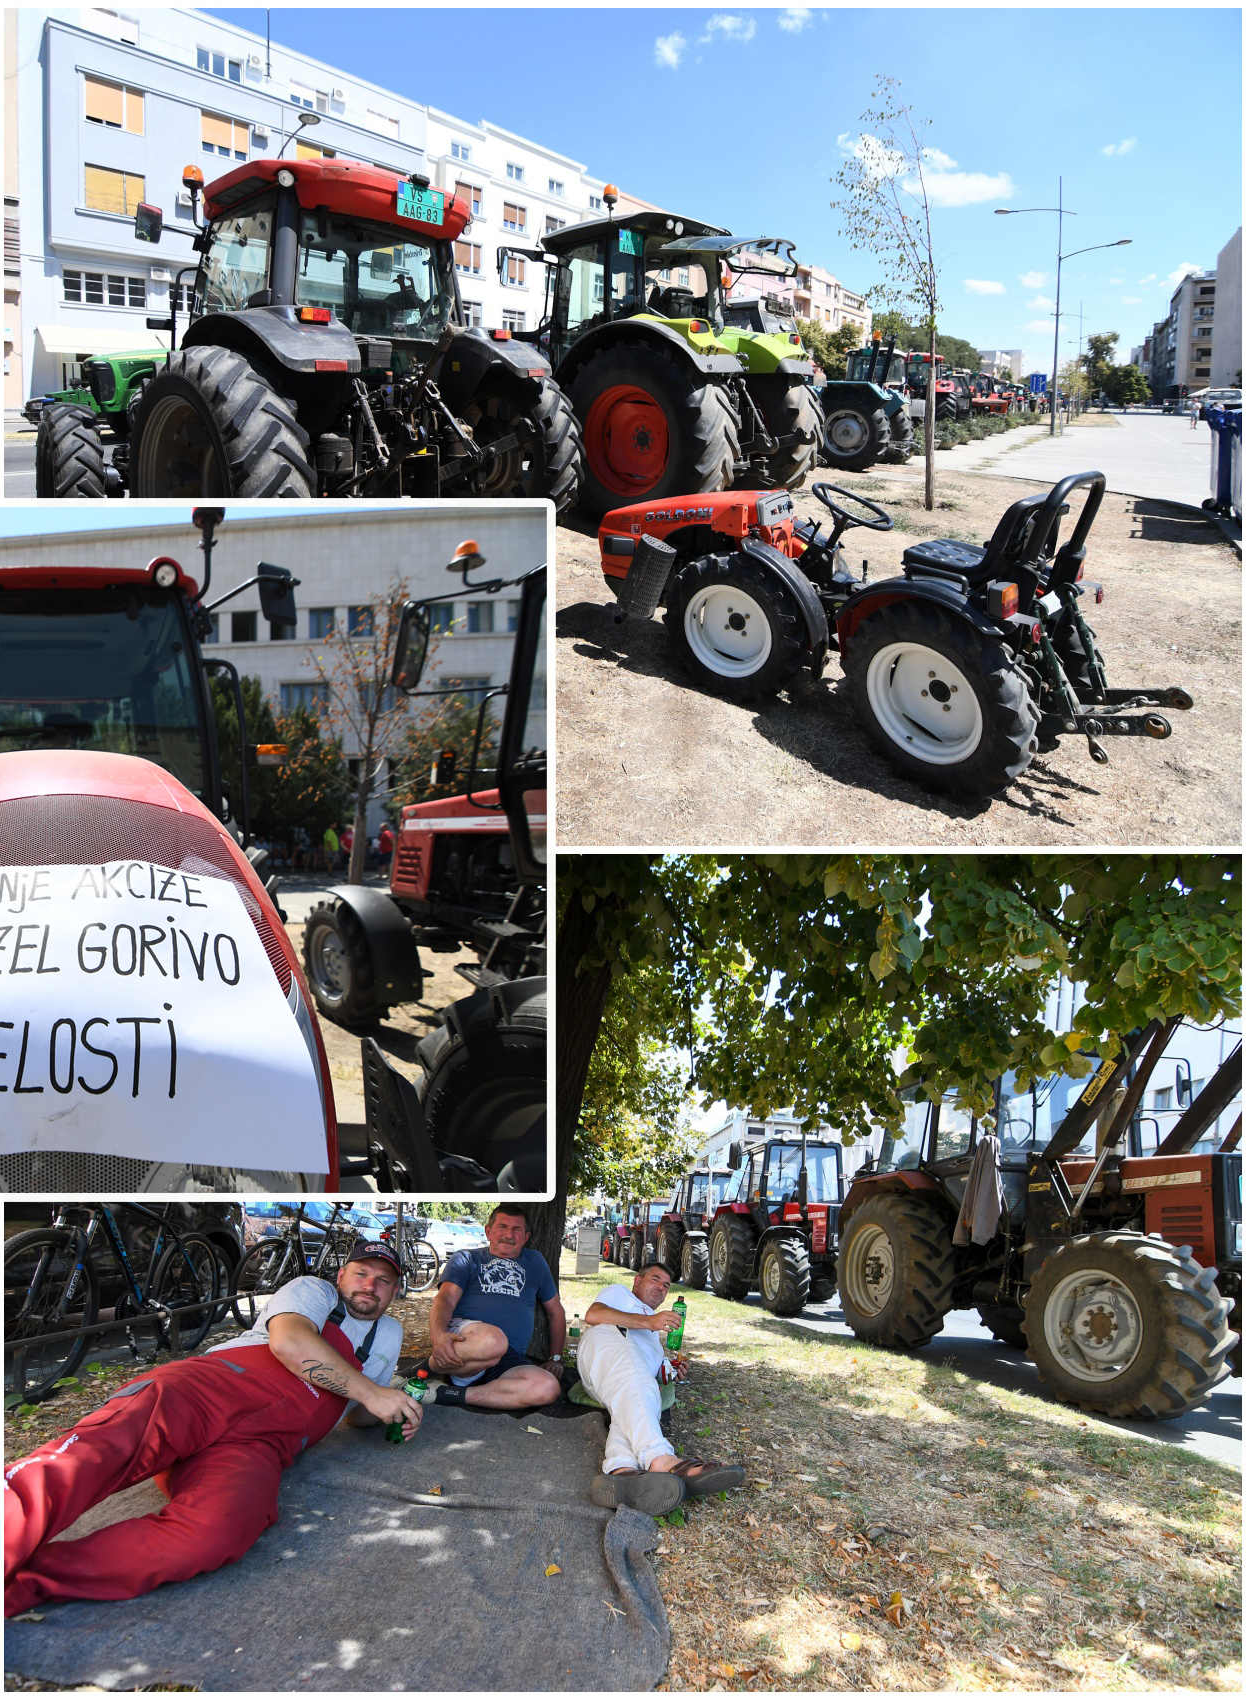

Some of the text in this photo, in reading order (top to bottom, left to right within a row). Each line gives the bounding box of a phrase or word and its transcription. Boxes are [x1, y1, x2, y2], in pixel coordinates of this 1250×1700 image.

[410, 187, 424, 202] VS
[403, 202, 438, 223] AAG-83
[644, 507, 714, 522] GOLDONI
[71, 863, 208, 909] AKCIZE
[77, 915, 242, 986] GORIVO
[481, 1284, 521, 1297] TIGERS
[301, 1359, 350, 1397] Ksenija
